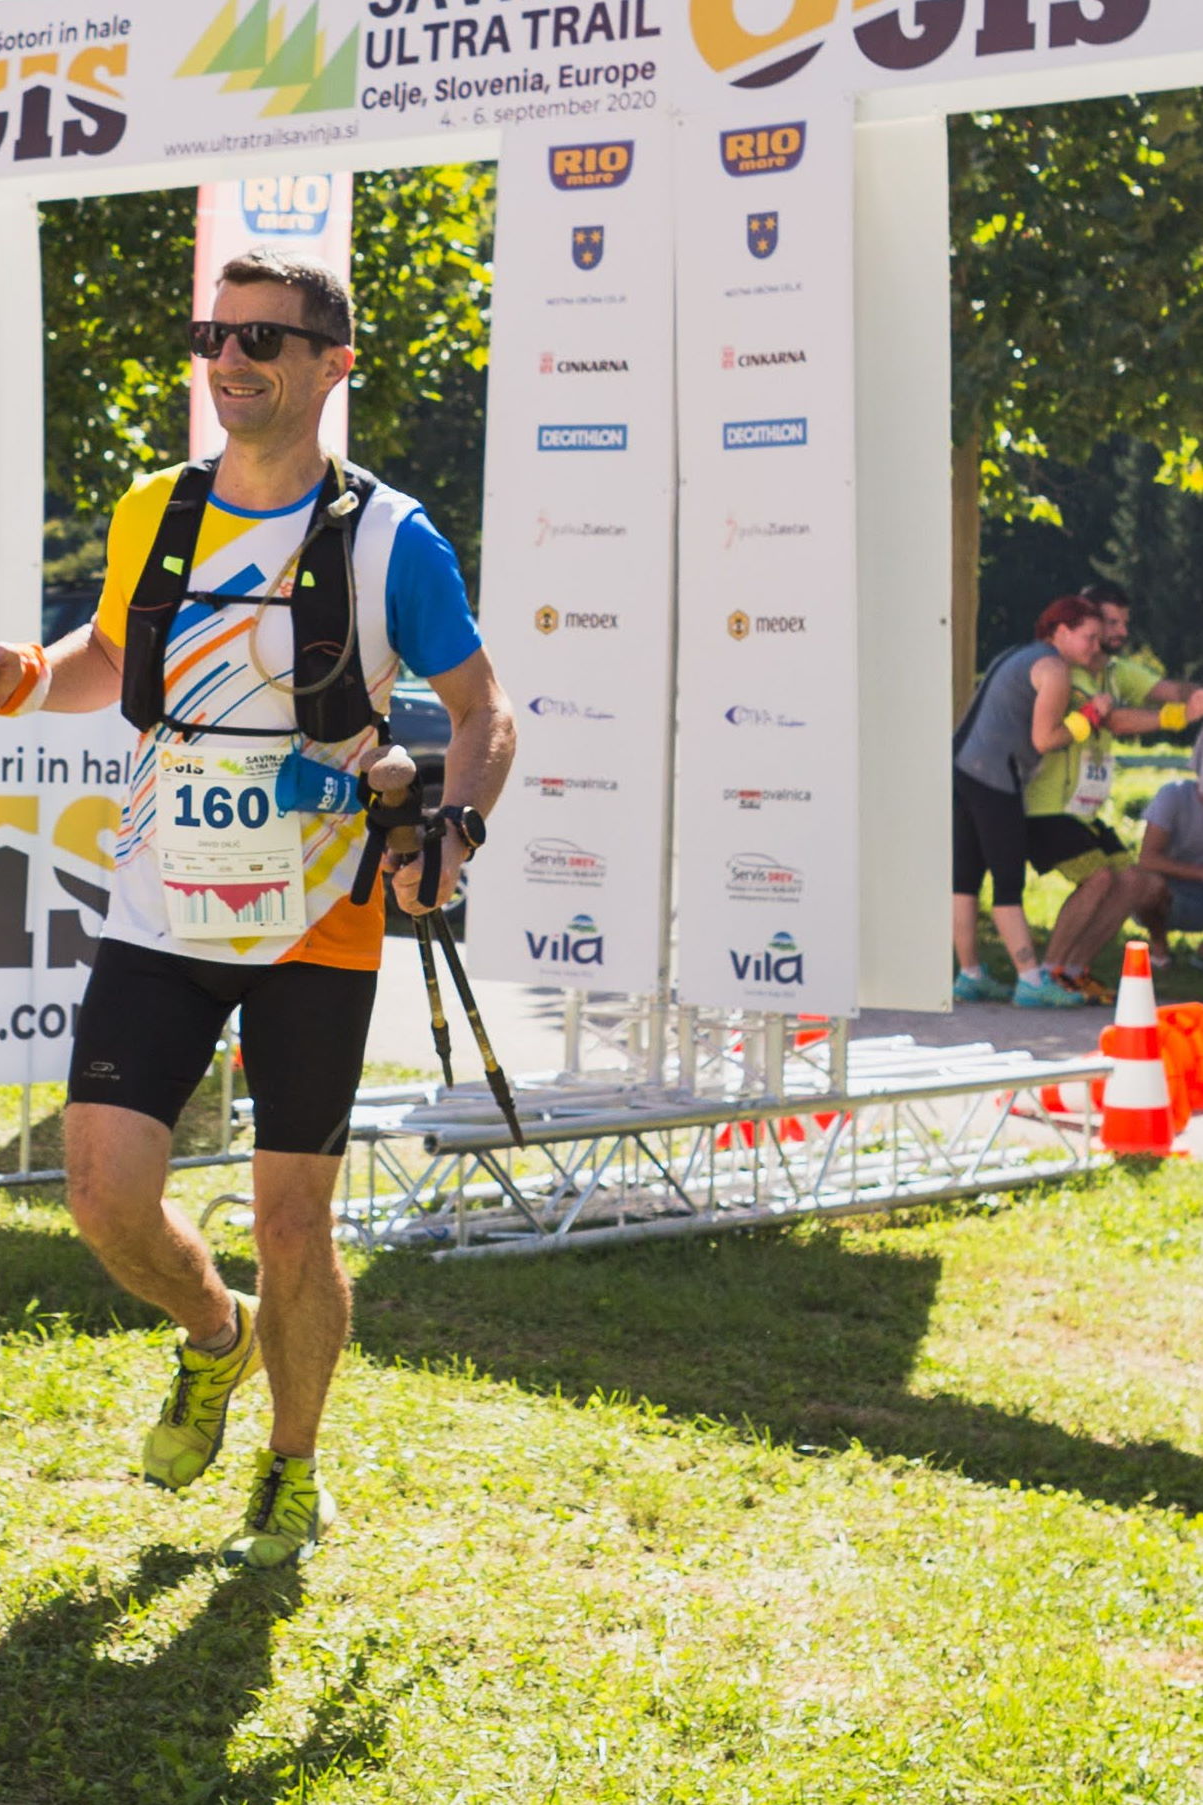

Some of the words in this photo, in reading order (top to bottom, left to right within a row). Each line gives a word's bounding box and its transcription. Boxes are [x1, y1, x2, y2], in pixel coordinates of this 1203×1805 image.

[59, 22, 78, 42] in
[84, 15, 131, 39] hale
[365, 15, 511, 69] ULTRA
[521, 0, 661, 56] TRAIL
[361, 82, 427, 113] Celje,
[434, 67, 550, 102] Slovenia,
[558, 60, 657, 88] Europe
[493, 96, 600, 125] september
[606, 89, 657, 113] 2020
[165, 121, 359, 157] www.ultratrailsavinja.si
[725, 128, 801, 161] RIO
[553, 146, 628, 175] RIO
[738, 156, 786, 171] mare
[565, 172, 614, 186] mare
[244, 175, 330, 214] RIO
[557, 360, 629, 373] CINKARNA
[738, 350, 807, 368] CINKARNA
[542, 428, 624, 446] DECATHLON
[725, 424, 804, 445] DECATHLON
[37, 746, 69, 784] in
[82, 749, 132, 785] hal
[245, 754, 285, 765] SAVINJ
[174, 784, 270, 830] 160
[529, 850, 567, 868] Servis
[731, 865, 766, 882] Servis
[525, 930, 604, 965] Vila
[730, 949, 805, 986] Vila
